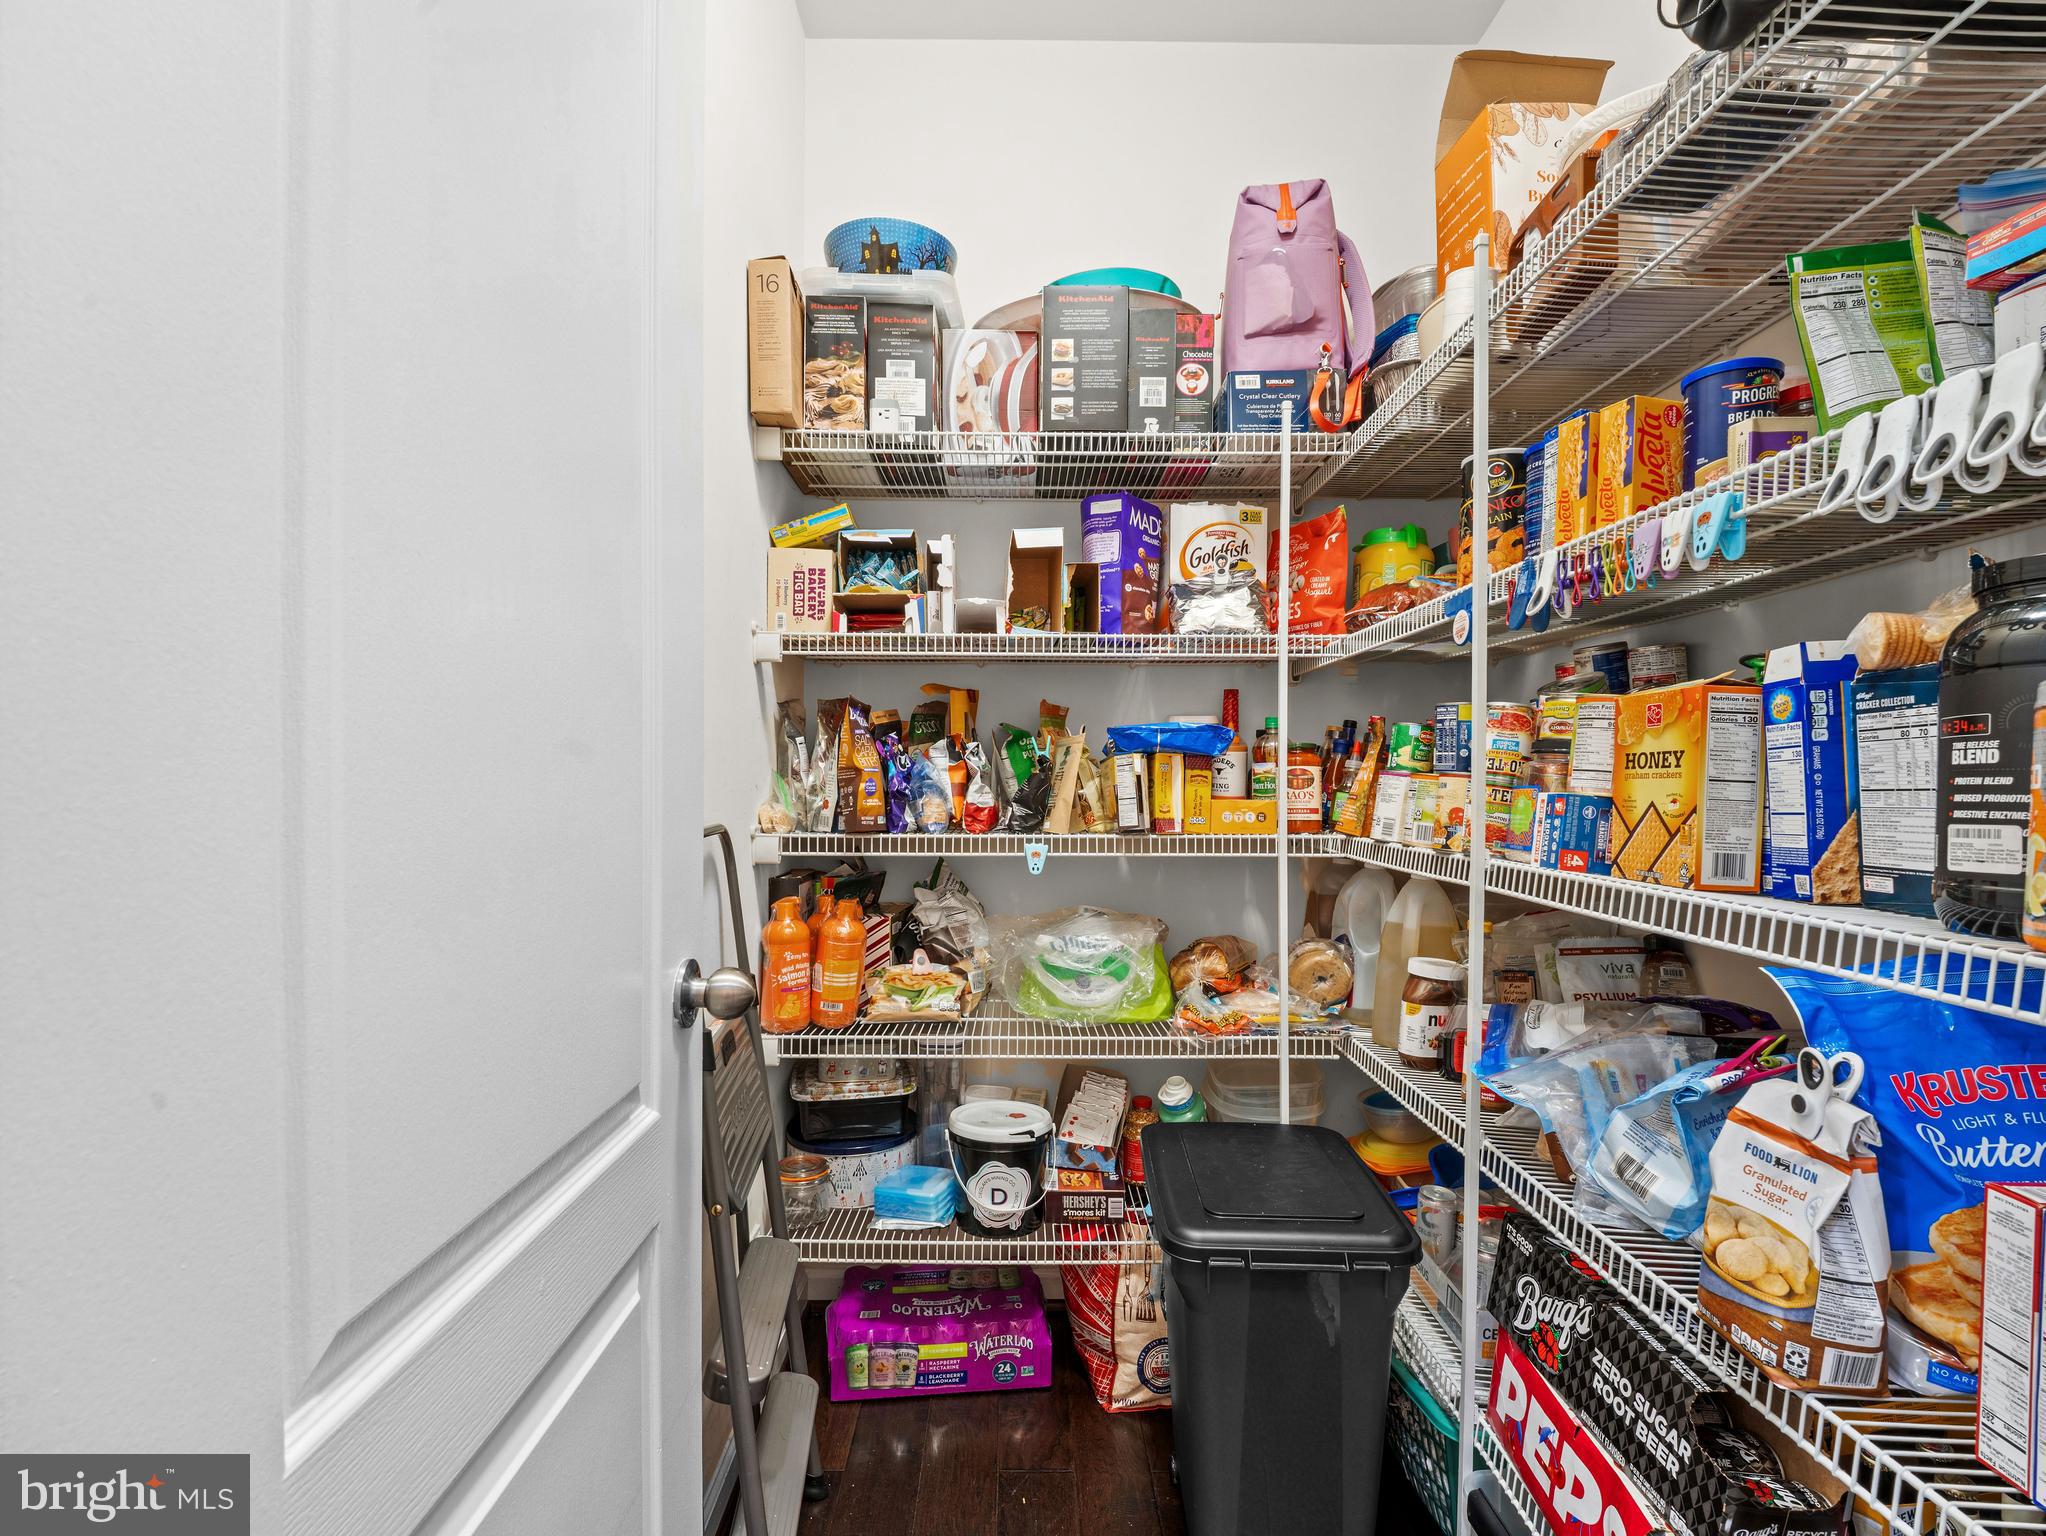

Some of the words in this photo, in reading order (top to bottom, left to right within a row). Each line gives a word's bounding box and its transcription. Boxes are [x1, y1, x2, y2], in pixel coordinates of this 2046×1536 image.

[756, 273, 780, 293] 16
[1800, 275, 1838, 285] Nutrition
[1840, 271, 1863, 280] Facts
[1058, 295, 1114, 303] KitchenAid
[1803, 303, 1826, 311] Calories
[1833, 301, 1847, 309] 230
[1852, 298, 1866, 307] 280
[873, 315, 928, 325] KitchenAid
[1182, 350, 1213, 359] Chocolate
[1279, 393, 1301, 401] Cutlery
[1599, 477, 1616, 523] lveeta
[1241, 511, 1249, 522] 3
[1189, 539, 1249, 569] Goldfish
[794, 573, 804, 592] FIG
[807, 568, 817, 620] BAKERY
[1305, 588, 1333, 598] Yogurt
[794, 593, 804, 614] BAR
[1855, 699, 1881, 710] CRACKER
[1880, 694, 1916, 707] COLLECTION
[1857, 713, 1877, 721] Nutrition
[1900, 729, 1911, 738] 80
[1918, 728, 1929, 736] 70
[1952, 741, 1965, 750] TIME
[1965, 740, 2000, 749] RELEASE
[1624, 749, 1686, 771] HONEY
[1951, 748, 2000, 765] BLEND
[1624, 770, 1651, 782] graham
[1651, 770, 1683, 780] crackers
[1954, 775, 1981, 786] PROTEIN
[1983, 775, 2014, 785] BLEND
[1954, 793, 1981, 803] INFUSED
[1953, 809, 1987, 820] DIGESTIVE
[1600, 961, 1634, 975] viva
[777, 970, 806, 985] Salmon
[1607, 972, 1634, 980] naturals
[1573, 991, 1637, 1002] PSYLLIUM
[1693, 1109, 1727, 1133] Enriched
[1952, 1114, 1996, 1131] LIGHT
[2004, 1113, 2018, 1125] &
[1744, 1142, 1773, 1164] FOOD
[1791, 1161, 1818, 1185] LION
[1742, 1164, 1807, 1202] Granulated
[991, 1187, 1008, 1206] D
[1754, 1183, 1788, 1206] Sugar
[1063, 1195, 1107, 1209] HERSHEY'S
[1063, 1208, 1094, 1218] s'mores
[1094, 1208, 1106, 1218] kit
[1515, 1231, 1534, 1253] GOOD
[891, 1295, 992, 1318] WATERLOO
[1513, 1273, 1594, 1355] Barq's
[968, 1332, 1034, 1361] WATERLOO
[928, 1359, 961, 1367] RASPBERRY
[928, 1364, 960, 1372] NECTARINE
[998, 1363, 1012, 1373] 24
[1931, 1366, 1951, 1378] NO
[928, 1377, 961, 1385] LEMONADE
[1589, 1347, 1631, 1401] ZERO
[1633, 1392, 1694, 1465] SUGAR
[1592, 1374, 1638, 1428] ROOT
[1634, 1423, 1680, 1480] BEER
